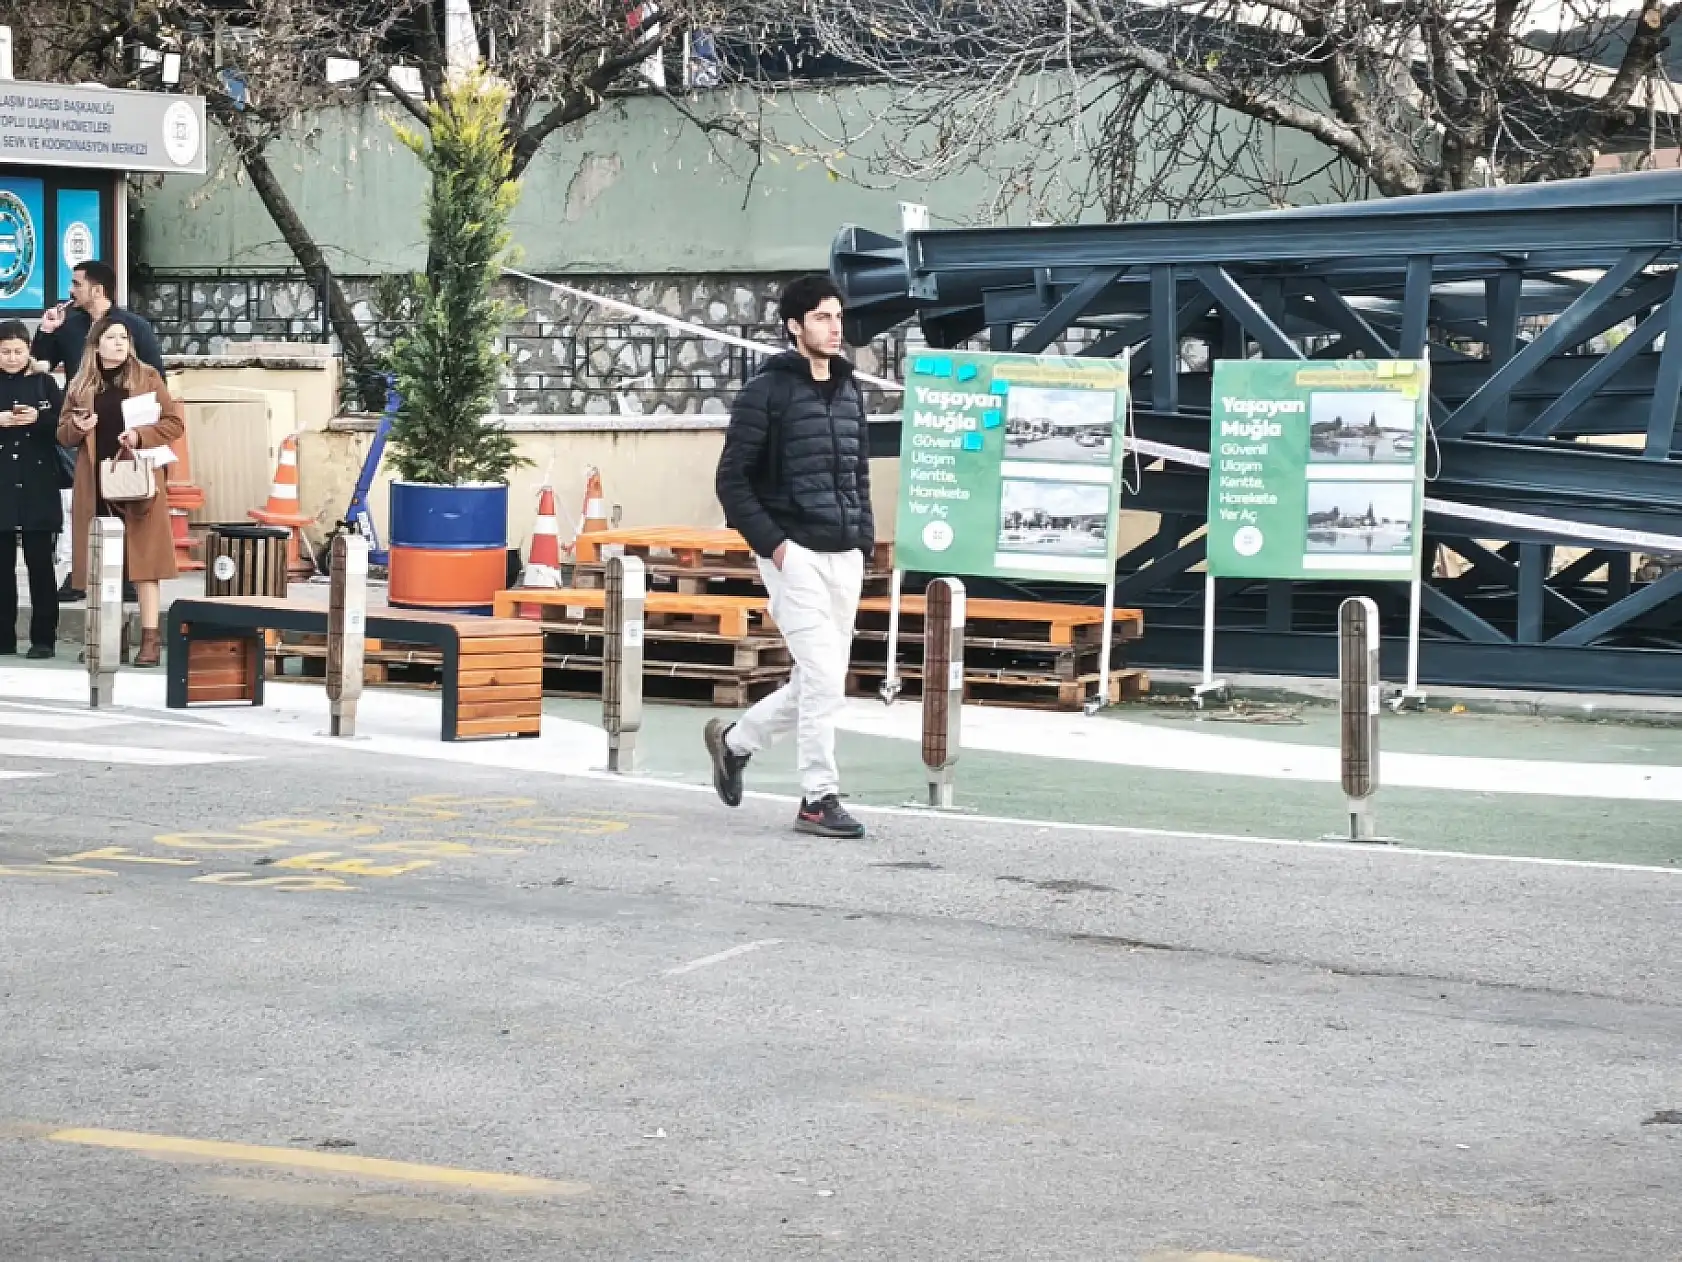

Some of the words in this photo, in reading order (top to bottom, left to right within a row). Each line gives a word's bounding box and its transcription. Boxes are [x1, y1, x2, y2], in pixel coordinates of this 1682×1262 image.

[914, 386, 1002, 411] Yaşayan
[1221, 396, 1306, 418] Yaşayan
[913, 410, 977, 433] Muğla
[1221, 418, 1282, 441] Muğla
